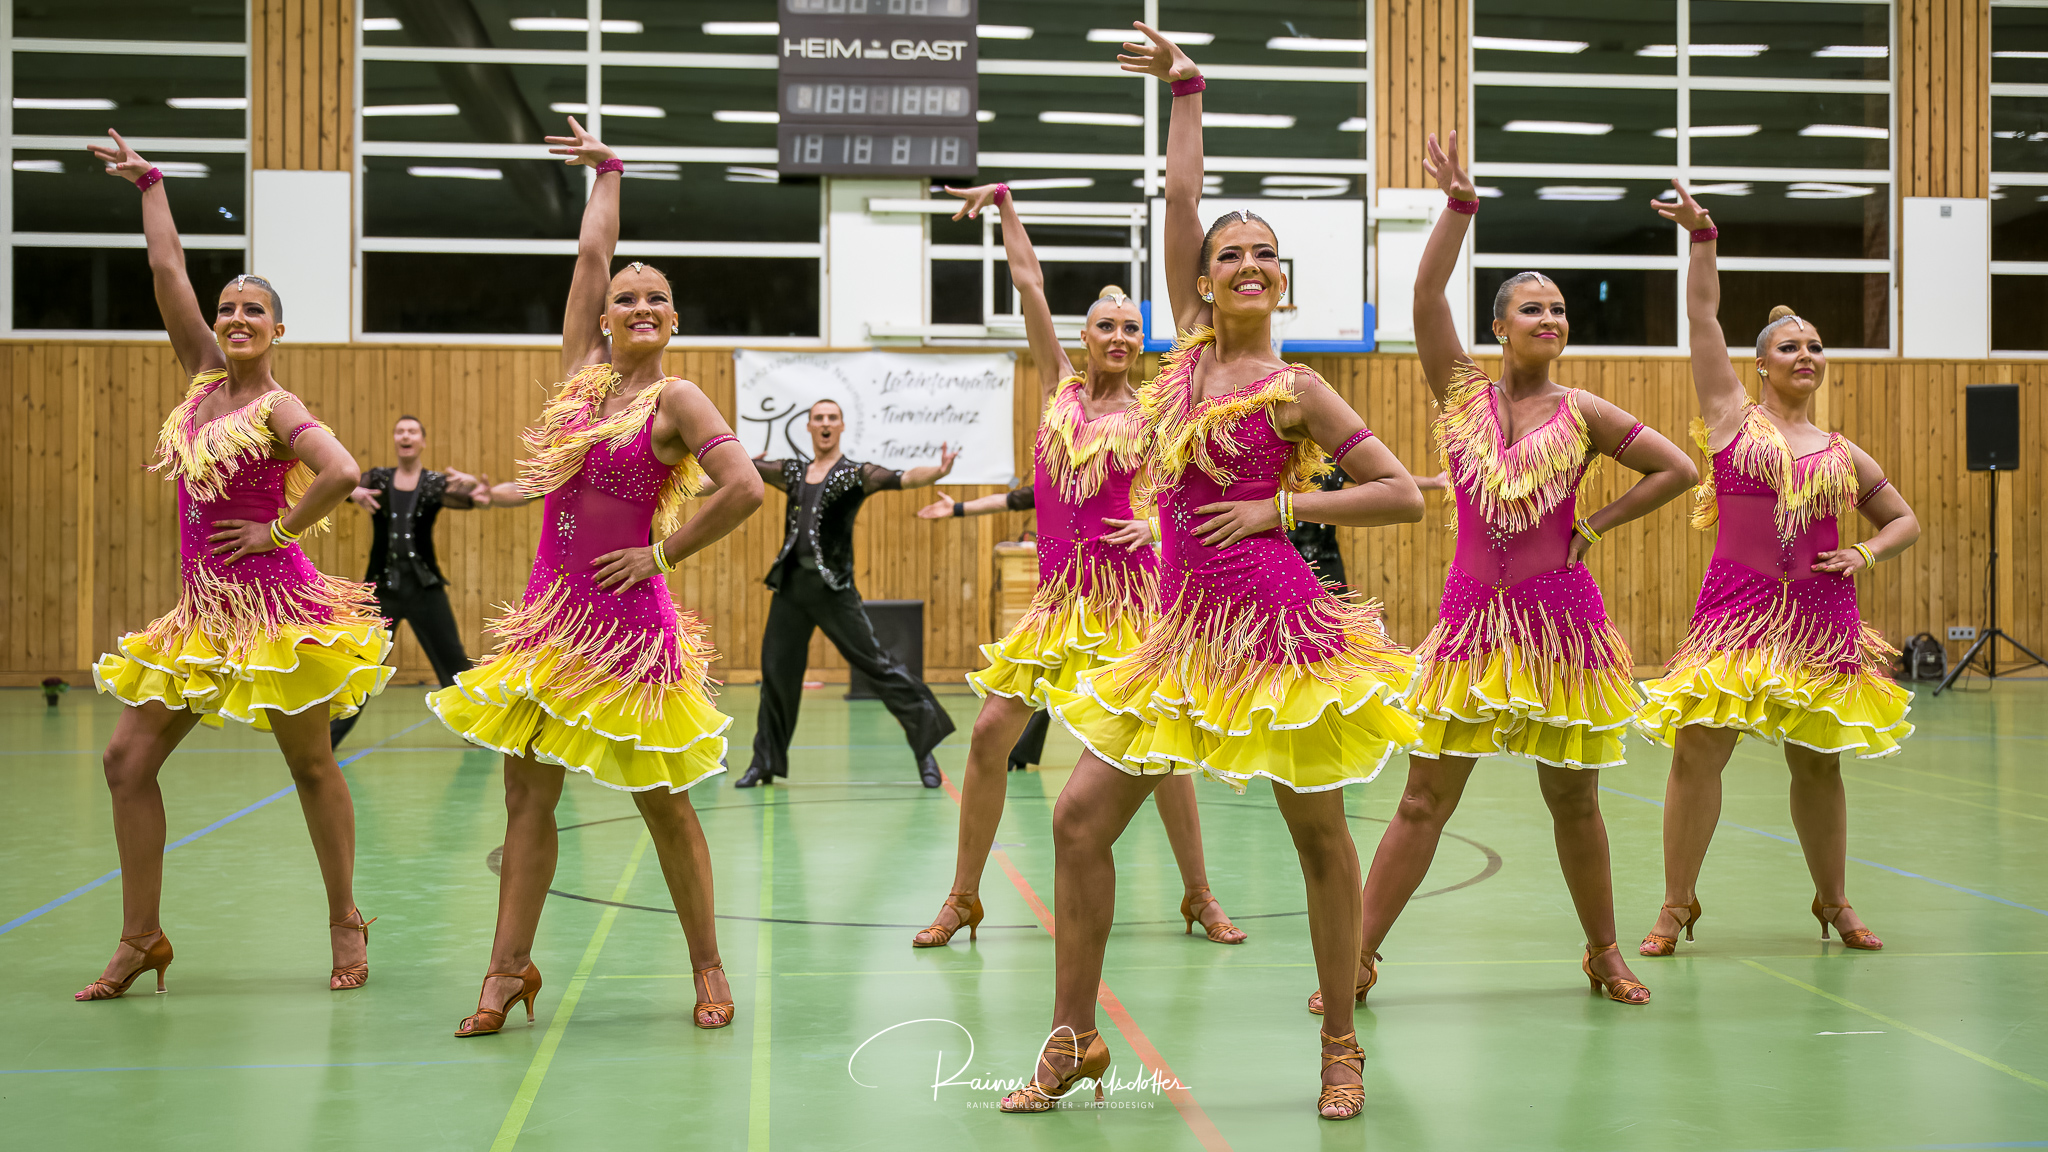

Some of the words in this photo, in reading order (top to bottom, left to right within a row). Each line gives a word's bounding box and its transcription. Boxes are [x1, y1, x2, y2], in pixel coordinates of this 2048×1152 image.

[783, 37, 862, 59] HEIM
[890, 39, 968, 61] GAST
[880, 403, 980, 425] Turniertanz
